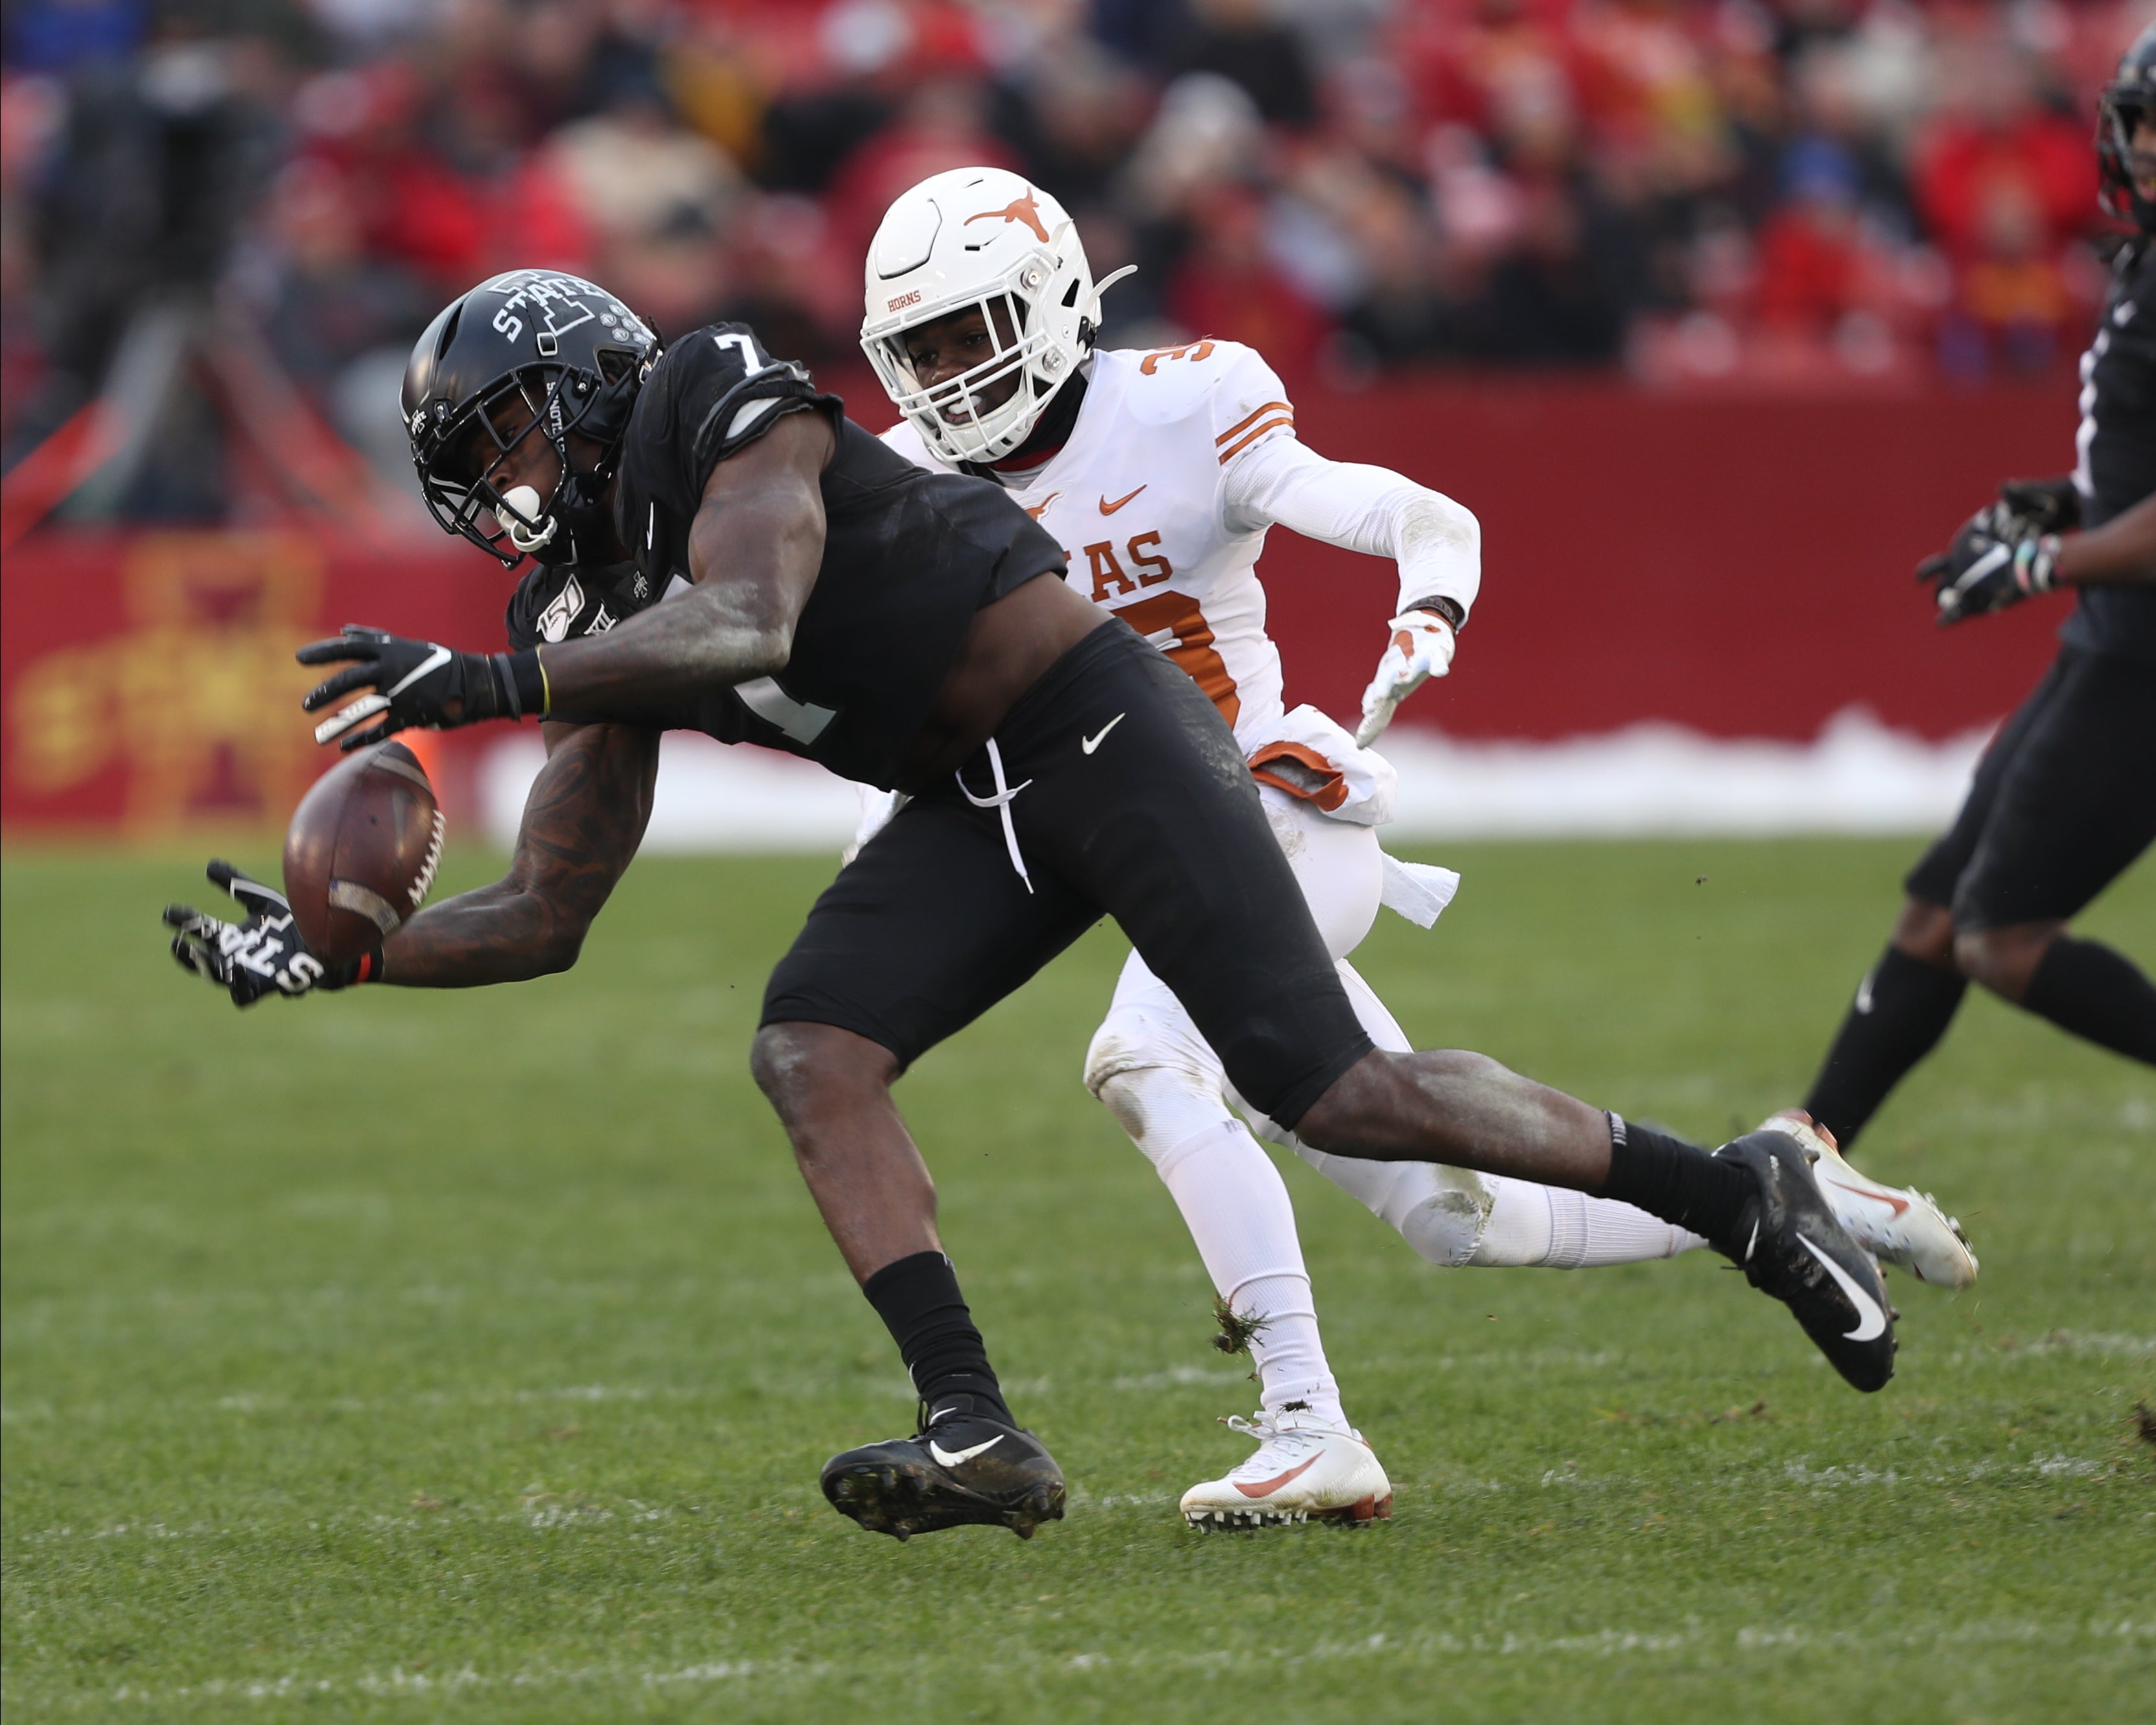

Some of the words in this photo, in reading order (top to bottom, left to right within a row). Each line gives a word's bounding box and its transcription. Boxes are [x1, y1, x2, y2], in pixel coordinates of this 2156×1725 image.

[493, 279, 606, 343] STATE
[887, 289, 922, 312] HORNS
[713, 333, 763, 376] 7
